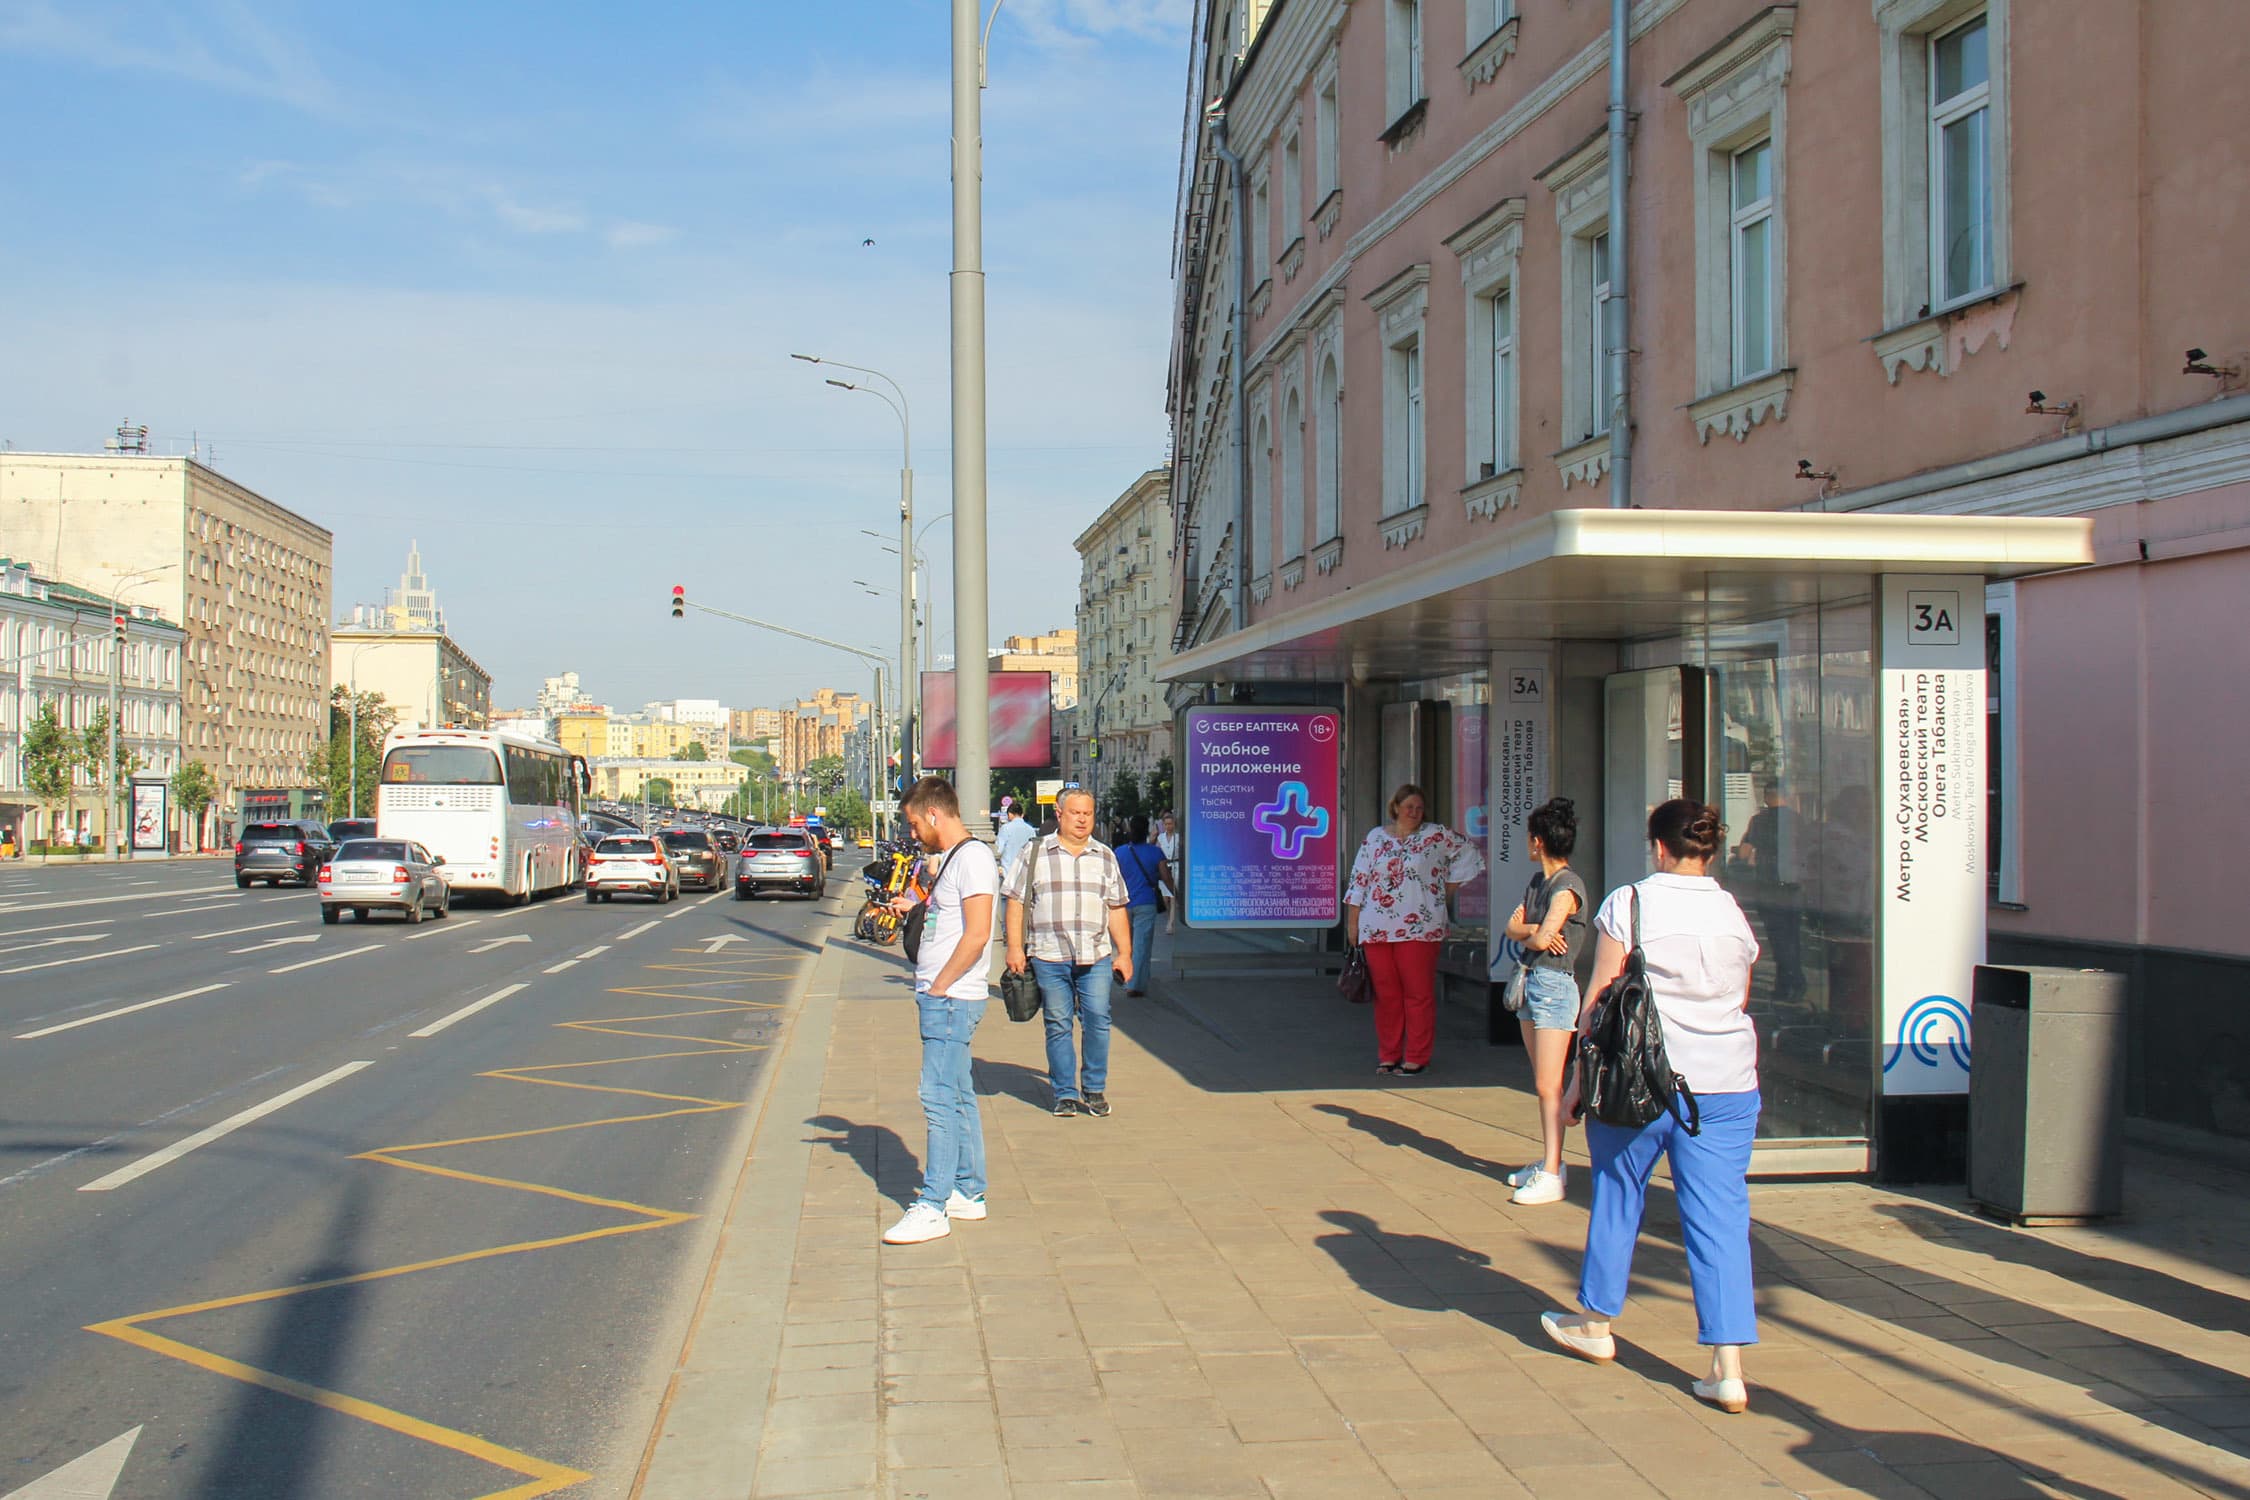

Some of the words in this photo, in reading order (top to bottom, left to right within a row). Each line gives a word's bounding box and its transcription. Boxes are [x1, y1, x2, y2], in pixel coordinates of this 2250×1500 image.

[1914, 604, 1954, 632] 3А
[1513, 677, 1538, 694] 3А
[1916, 674, 1930, 723] театр
[1964, 674, 1975, 728] Tabakova
[1212, 722, 1244, 732] СБЕР
[1246, 722, 1300, 732] ЕАПТЕКА
[1313, 724, 1331, 734] 18+
[1931, 674, 1946, 758] Табакова
[1950, 690, 1963, 779] Sukharevskaya
[1201, 741, 1270, 757] Удобное
[1513, 720, 1523, 752] театр
[1523, 720, 1533, 772] Табакова
[1964, 731, 1977, 768] Olega
[1201, 763, 1301, 776] приложение
[1500, 735, 1512, 821] «Сухаревская»
[1896, 698, 1913, 835] «Сухаревская»
[1965, 771, 1975, 800] Teatr
[1201, 798, 1232, 806] тысяч
[1210, 785, 1254, 794] десятки
[1511, 754, 1522, 826] Московский
[1523, 776, 1533, 810] Олега
[1914, 729, 1929, 843] Московский
[1932, 763, 1946, 818] Олега
[1951, 782, 1961, 820] Metro
[1201, 811, 1245, 821] товаров
[1499, 823, 1511, 863] Метро
[1965, 803, 1977, 875] Moskovskiy
[1896, 840, 1913, 902] Метро
